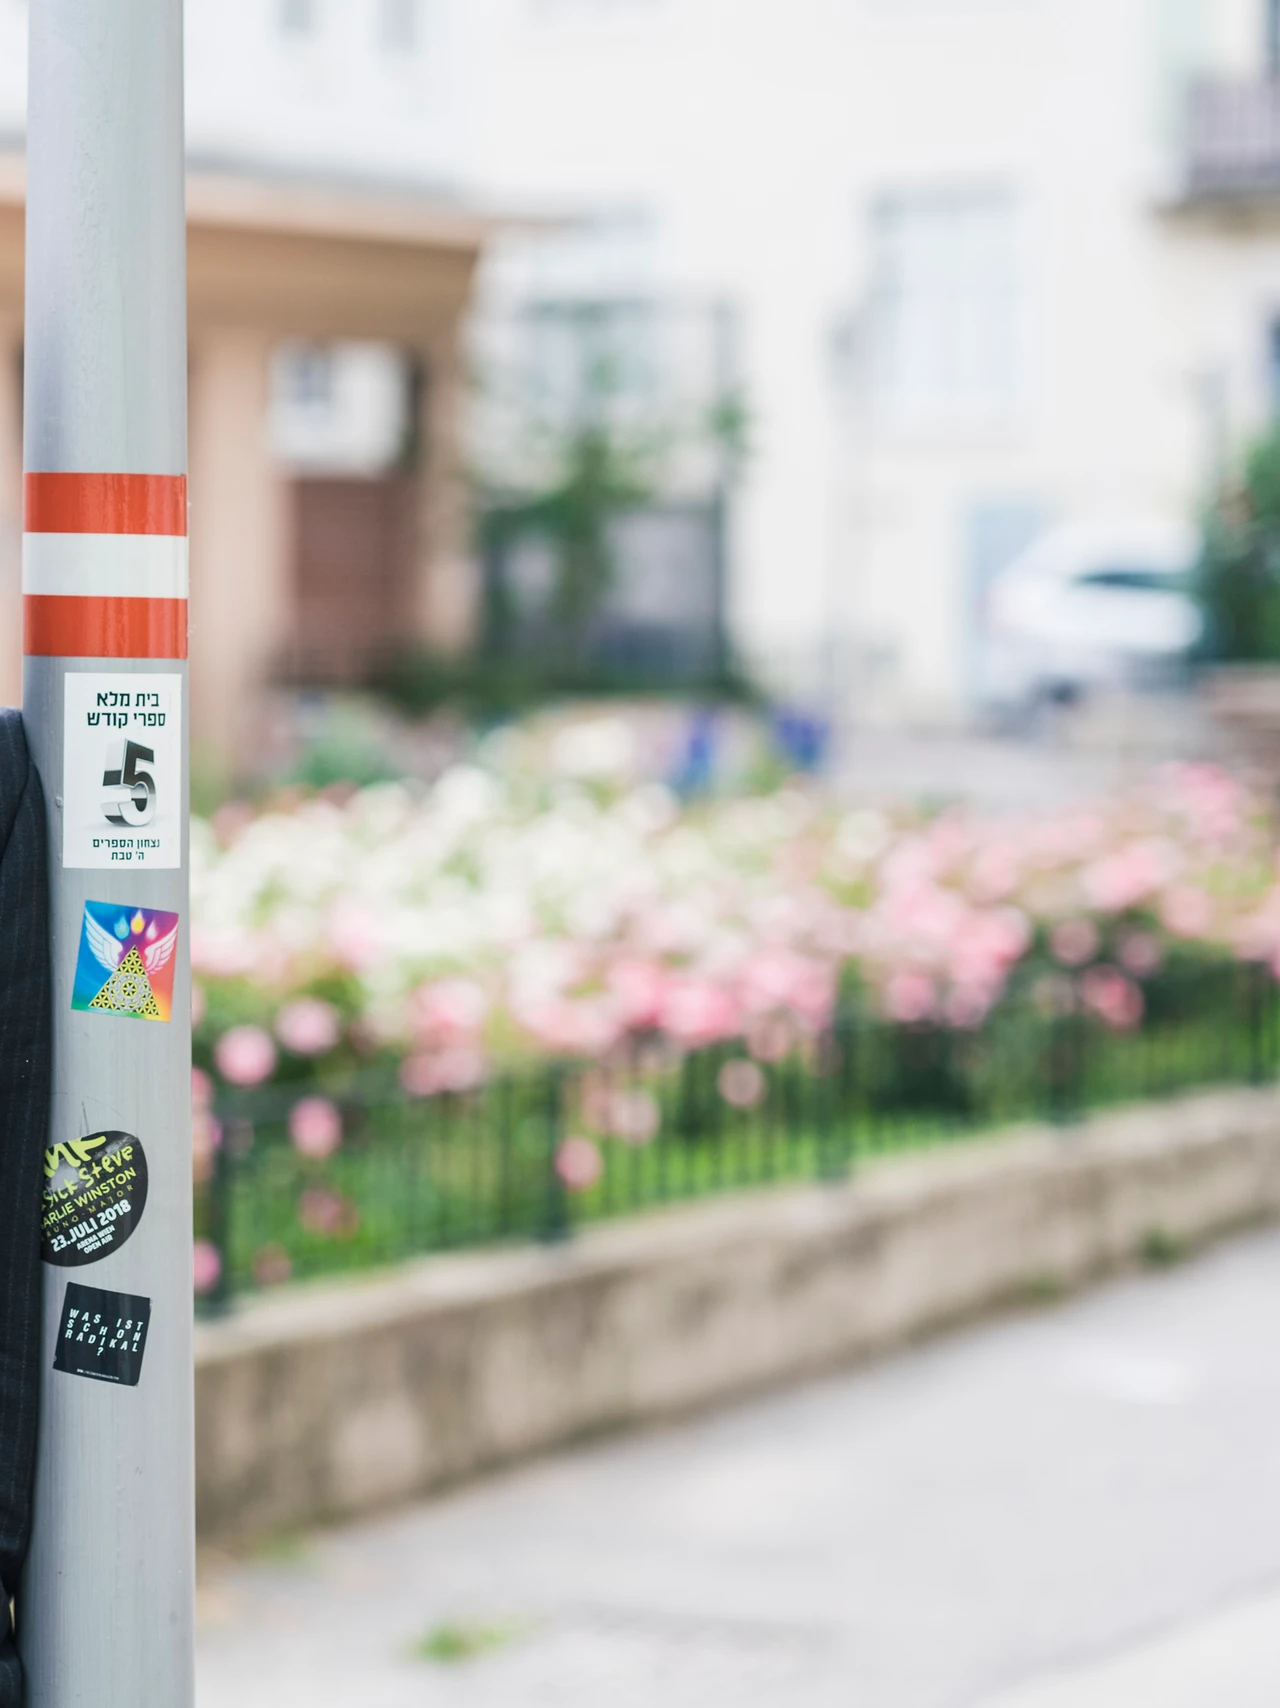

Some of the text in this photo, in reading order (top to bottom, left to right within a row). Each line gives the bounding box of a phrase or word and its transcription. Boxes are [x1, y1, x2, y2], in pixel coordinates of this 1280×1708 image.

[96, 691, 160, 707] בית מלא
[87, 712, 166, 729] ספרי קודש
[101, 738, 156, 826] 5
[92, 838, 160, 849] נצחון הספרים
[111, 851, 132, 861] טבת
[41, 1167, 137, 1230] ARLIE WINSTON
[97, 1199, 132, 1226] 2018
[77, 1225, 115, 1250] ARENA WIEN
[83, 1235, 113, 1254] OPEN AIR
[67, 1318, 142, 1342] SCHON
[70, 1309, 144, 1331] WAS IST
[65, 1329, 138, 1352] RADIKAL
[97, 1347, 104, 1356] ?
